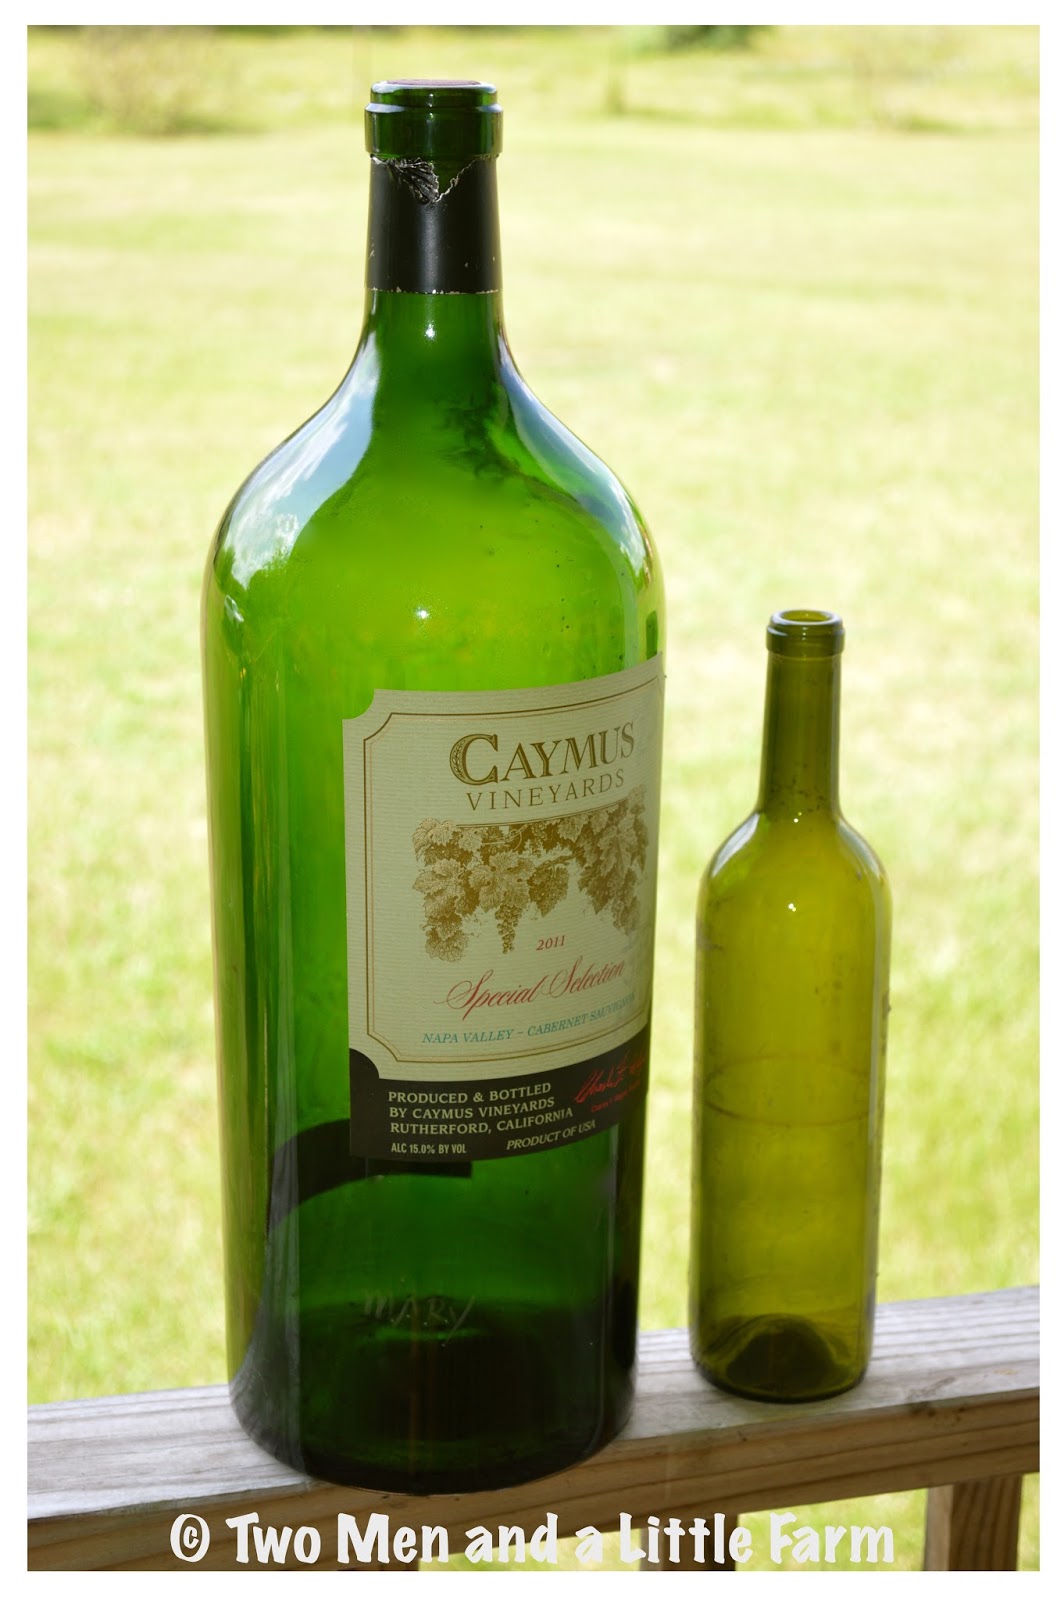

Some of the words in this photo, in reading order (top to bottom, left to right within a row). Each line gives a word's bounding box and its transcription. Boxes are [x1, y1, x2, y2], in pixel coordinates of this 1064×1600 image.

[450, 721, 635, 785] CAYMUS
[466, 769, 625, 811] VINEYARDS
[536, 935, 566, 951] 2011
[433, 969, 548, 1021] Special
[542, 955, 625, 998] Selection
[422, 1033, 458, 1044] NAPA
[463, 1029, 514, 1043] VALLEY
[527, 1014, 588, 1037] CABERNET
[388, 1091, 468, 1104] PRODUCED
[473, 1092, 484, 1103] &
[489, 1082, 552, 1101] BOTTLED
[389, 1107, 408, 1118] BY
[412, 1107, 474, 1119] CAYMUS
[478, 1096, 555, 1118] VINEYARDS
[390, 1122, 492, 1135] RUTHERFORD,
[496, 1107, 573, 1131] CALIFORNIA
[506, 1131, 560, 1150] PRODUCT
[562, 1125, 578, 1139] OF
[577, 1119, 596, 1135] USA
[391, 1142, 407, 1154] ALC
[409, 1143, 436, 1155] 15.0%
[438, 1143, 450, 1154] BY
[451, 1142, 467, 1154] VOL
